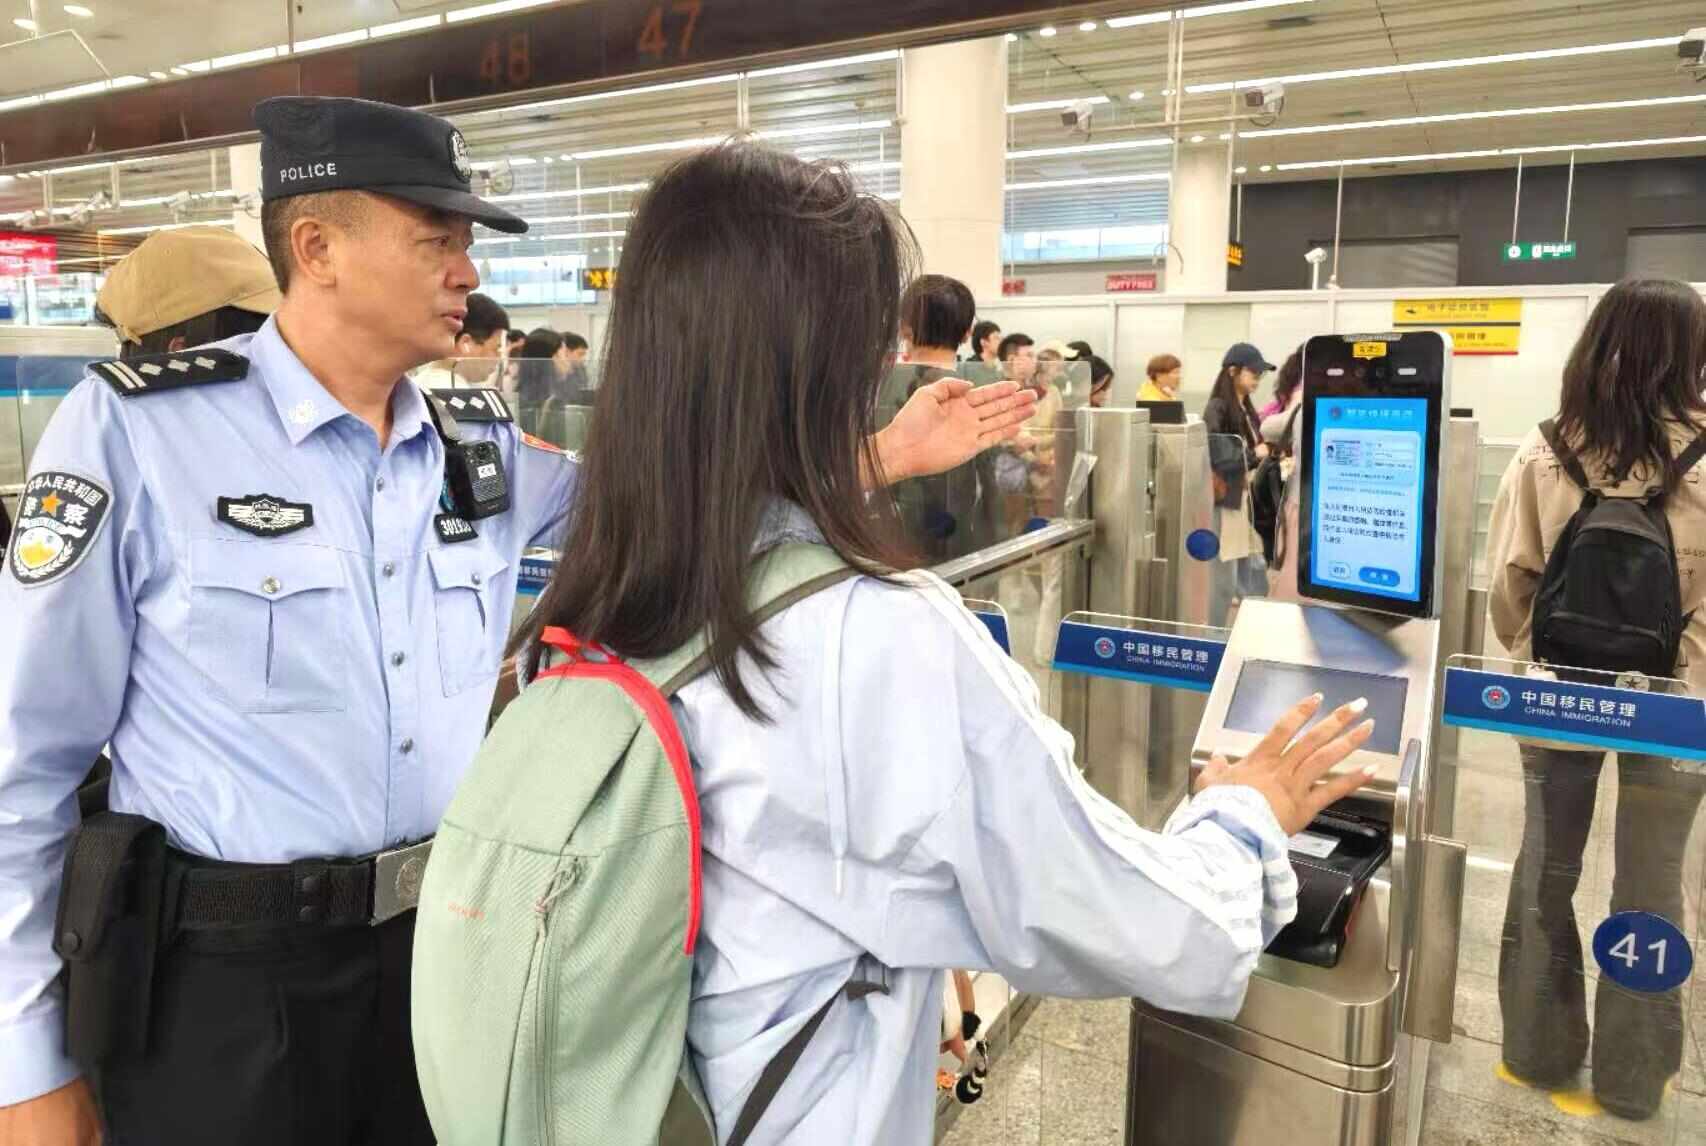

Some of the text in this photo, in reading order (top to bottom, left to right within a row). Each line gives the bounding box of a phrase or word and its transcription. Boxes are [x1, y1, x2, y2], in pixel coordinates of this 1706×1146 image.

[638, 1, 703, 61] 47
[480, 31, 531, 84] 48
[280, 162, 337, 183] POLICE
[1123, 640, 1209, 663] 中国移民管理
[1126, 655, 1205, 672] CHINA IMMIGRATION
[1521, 690, 1636, 718] 中国移民管理
[1524, 706, 1631, 728] CHINA IMMIGRATION
[1608, 932, 1667, 975] 41
